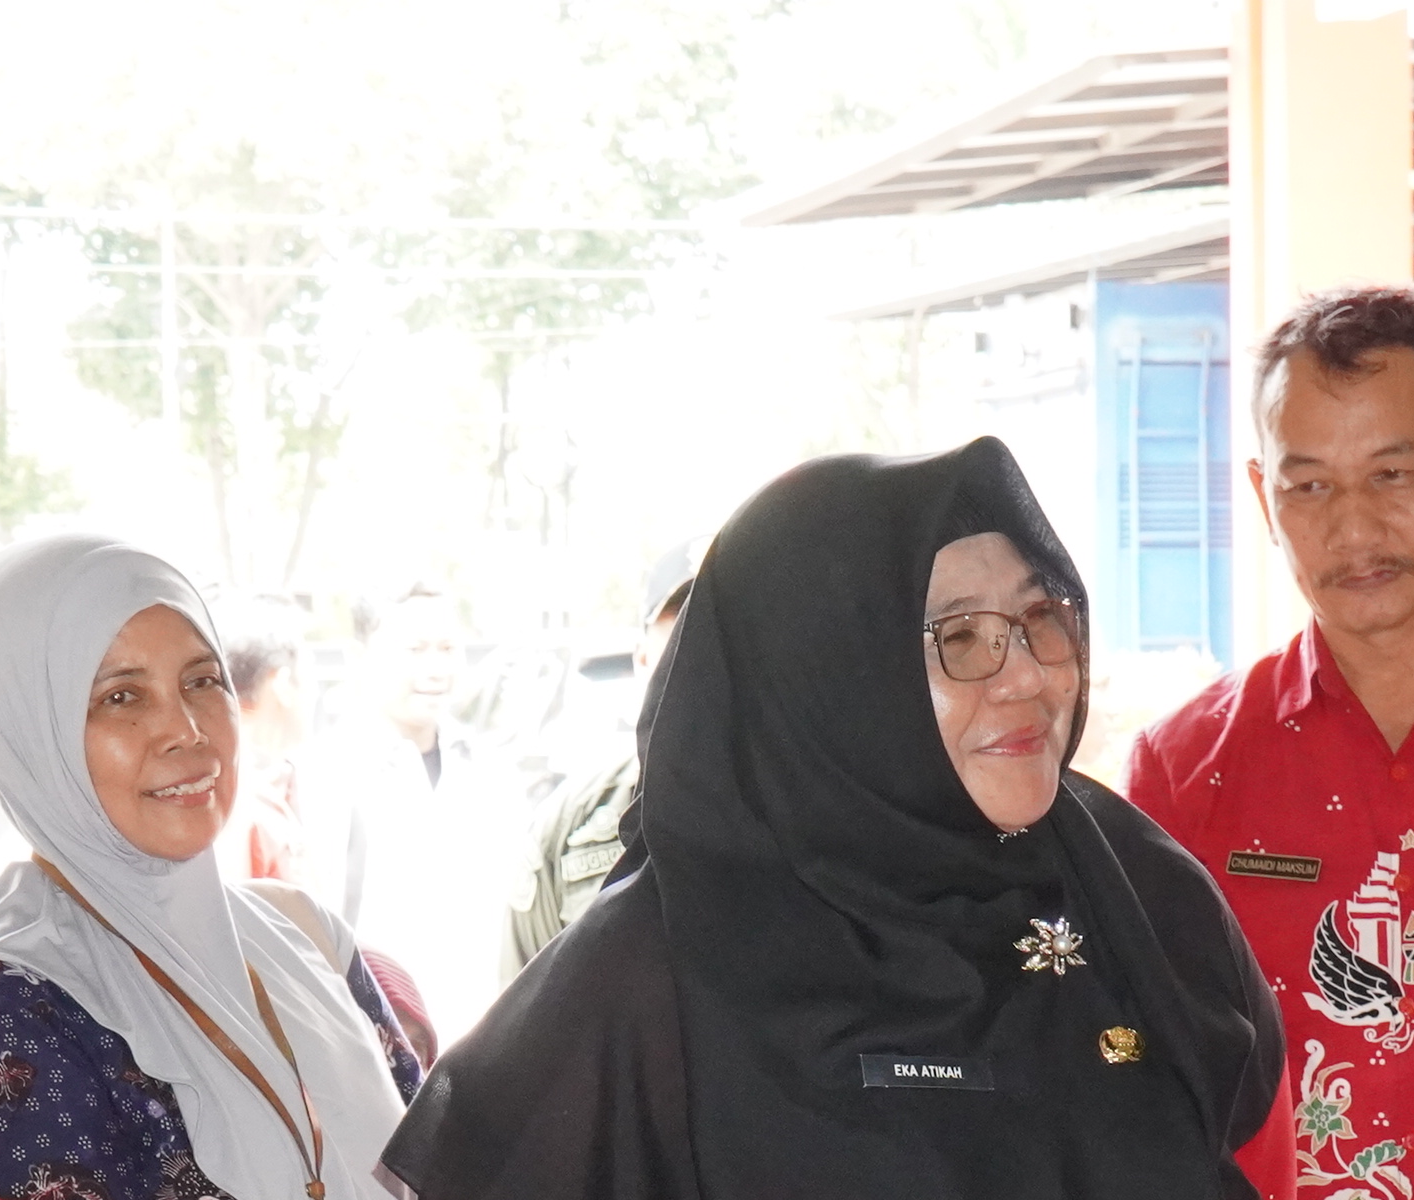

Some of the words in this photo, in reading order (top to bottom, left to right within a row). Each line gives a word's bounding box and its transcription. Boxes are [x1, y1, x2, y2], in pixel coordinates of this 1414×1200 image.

[566, 846, 626, 876] NUGRO
[894, 1064, 918, 1077] EKA
[921, 1065, 962, 1079] ATIKAH
